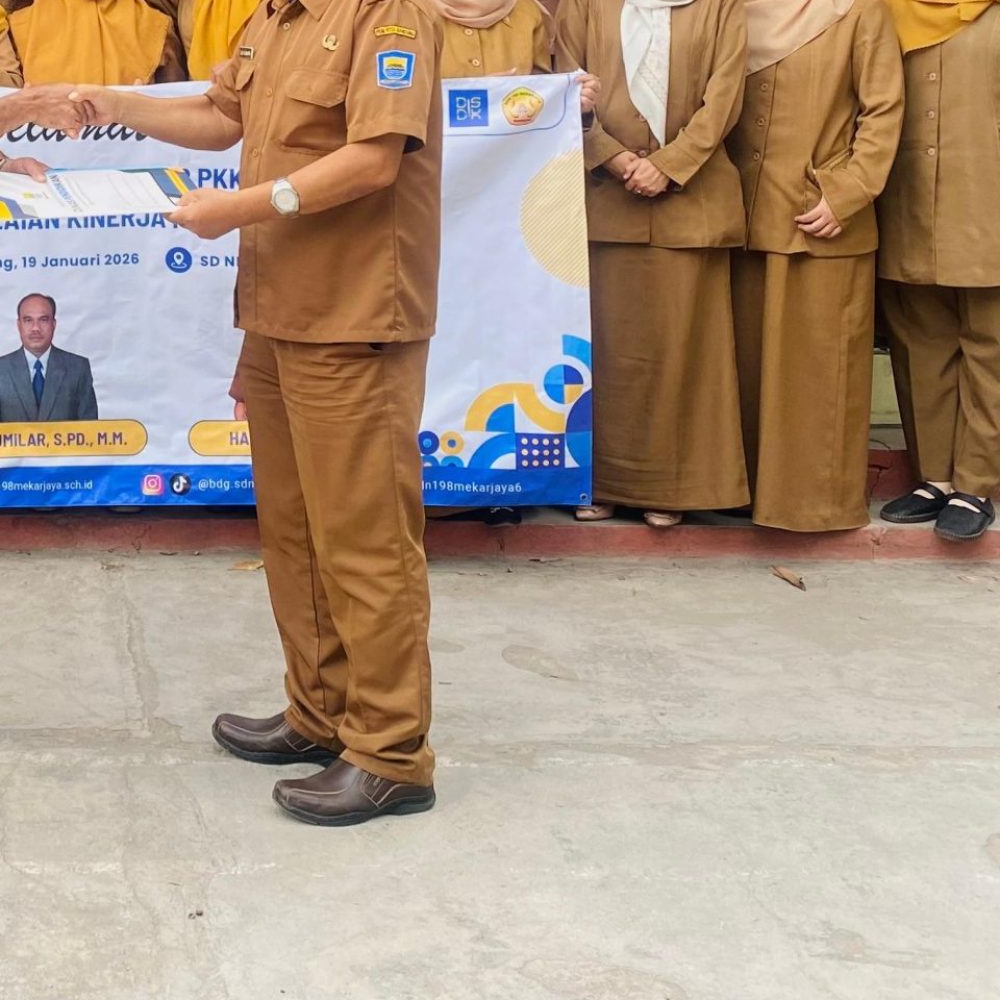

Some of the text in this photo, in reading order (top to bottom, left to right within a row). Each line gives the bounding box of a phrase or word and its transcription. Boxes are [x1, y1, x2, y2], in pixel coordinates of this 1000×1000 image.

[198, 168, 239, 189] PKK
[22, 256, 37, 268] 19
[41, 253, 100, 268] Januari
[104, 253, 140, 265] 2026
[200, 255, 220, 267] SD
[54, 432, 93, 447] S.PD.,
[97, 431, 128, 446] M.M.
